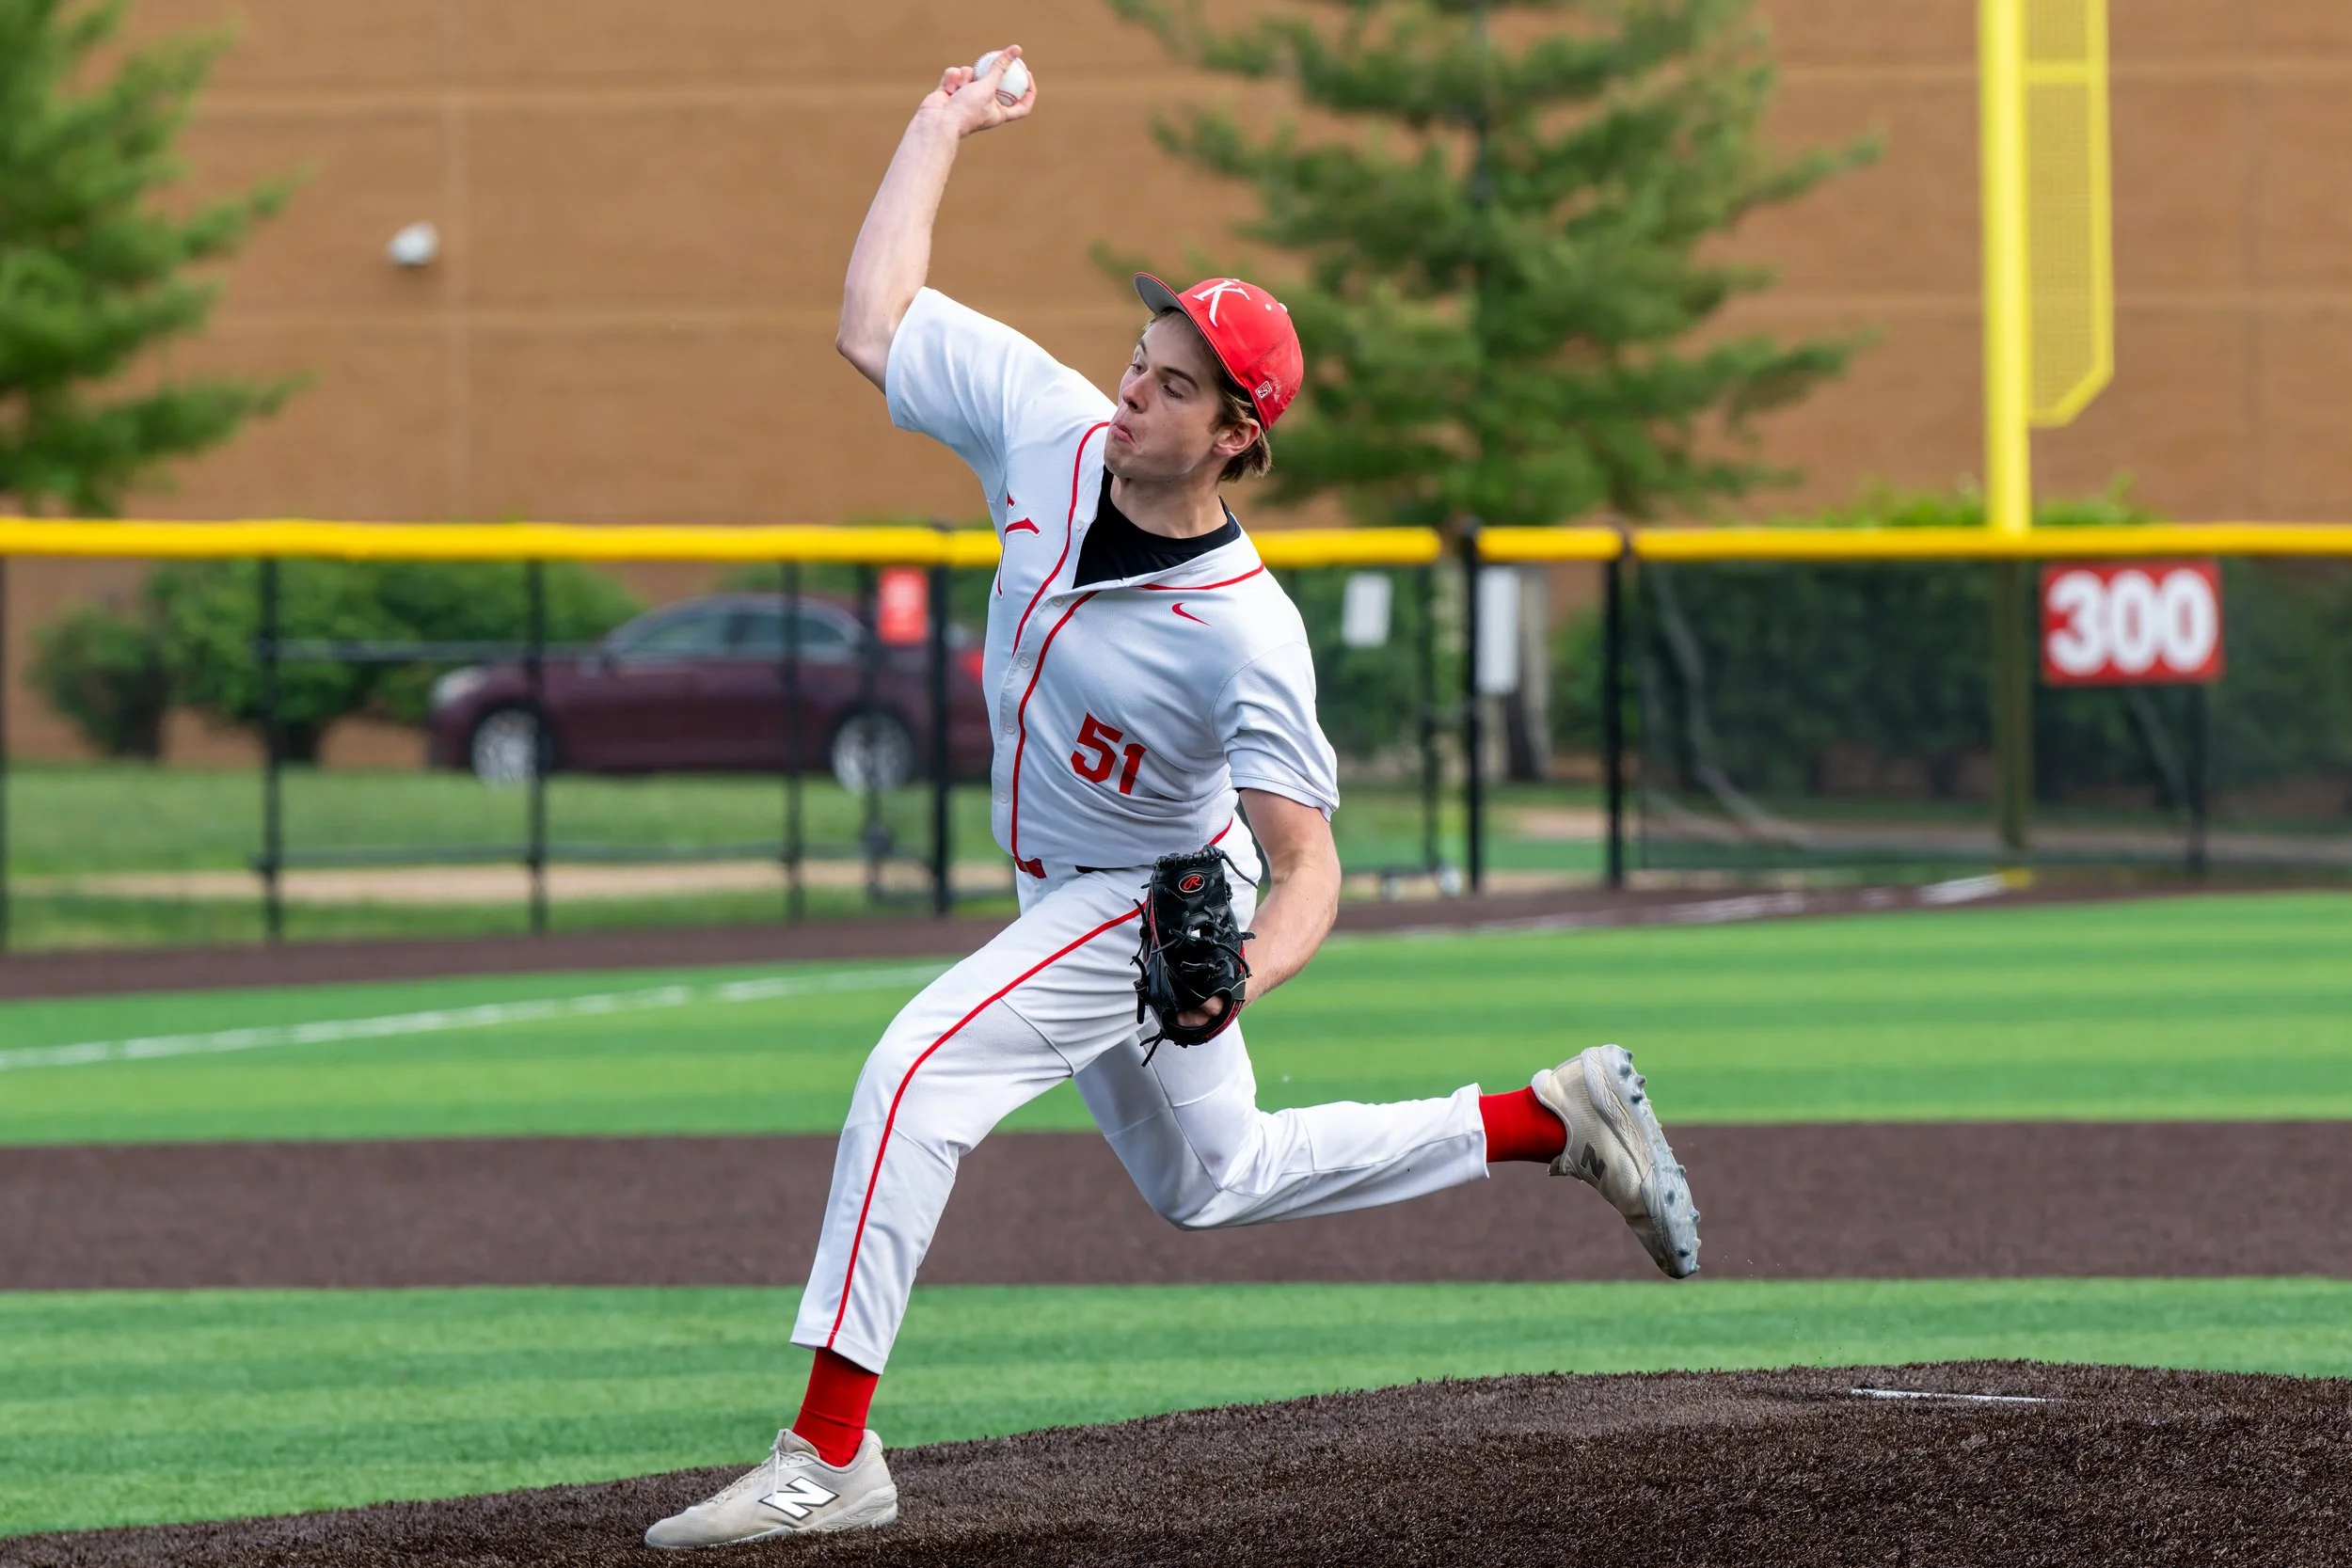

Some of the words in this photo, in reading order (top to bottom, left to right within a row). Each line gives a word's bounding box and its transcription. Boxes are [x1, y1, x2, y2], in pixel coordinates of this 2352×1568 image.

[1193, 280, 1250, 327] K
[2046, 569, 2218, 675] 300
[1071, 711, 1147, 796] 51
[1183, 876, 1202, 890] R
[758, 1476, 840, 1521] N
